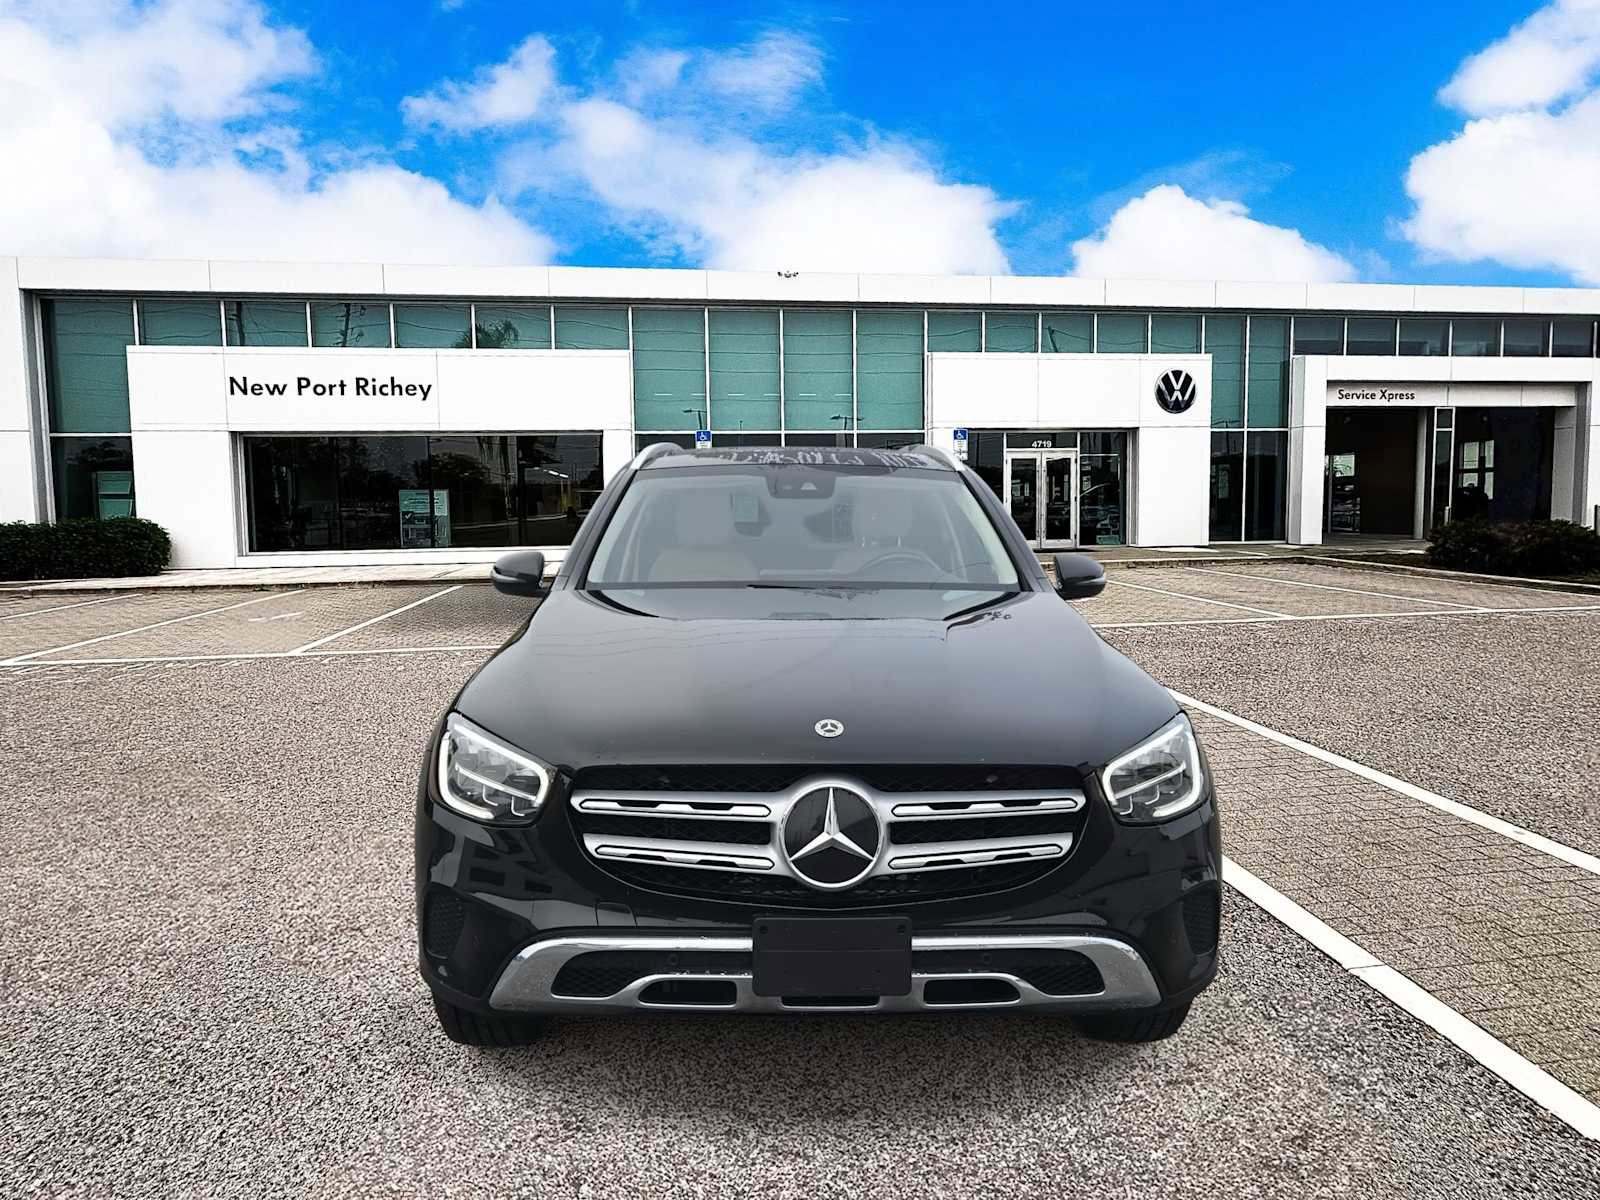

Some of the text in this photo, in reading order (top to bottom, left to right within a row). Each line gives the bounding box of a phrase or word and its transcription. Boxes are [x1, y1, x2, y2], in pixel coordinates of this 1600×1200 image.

[229, 376, 432, 401] New Port Richey
[1337, 388, 1416, 402] Service Xpress
[1031, 440, 1052, 448] 4719
